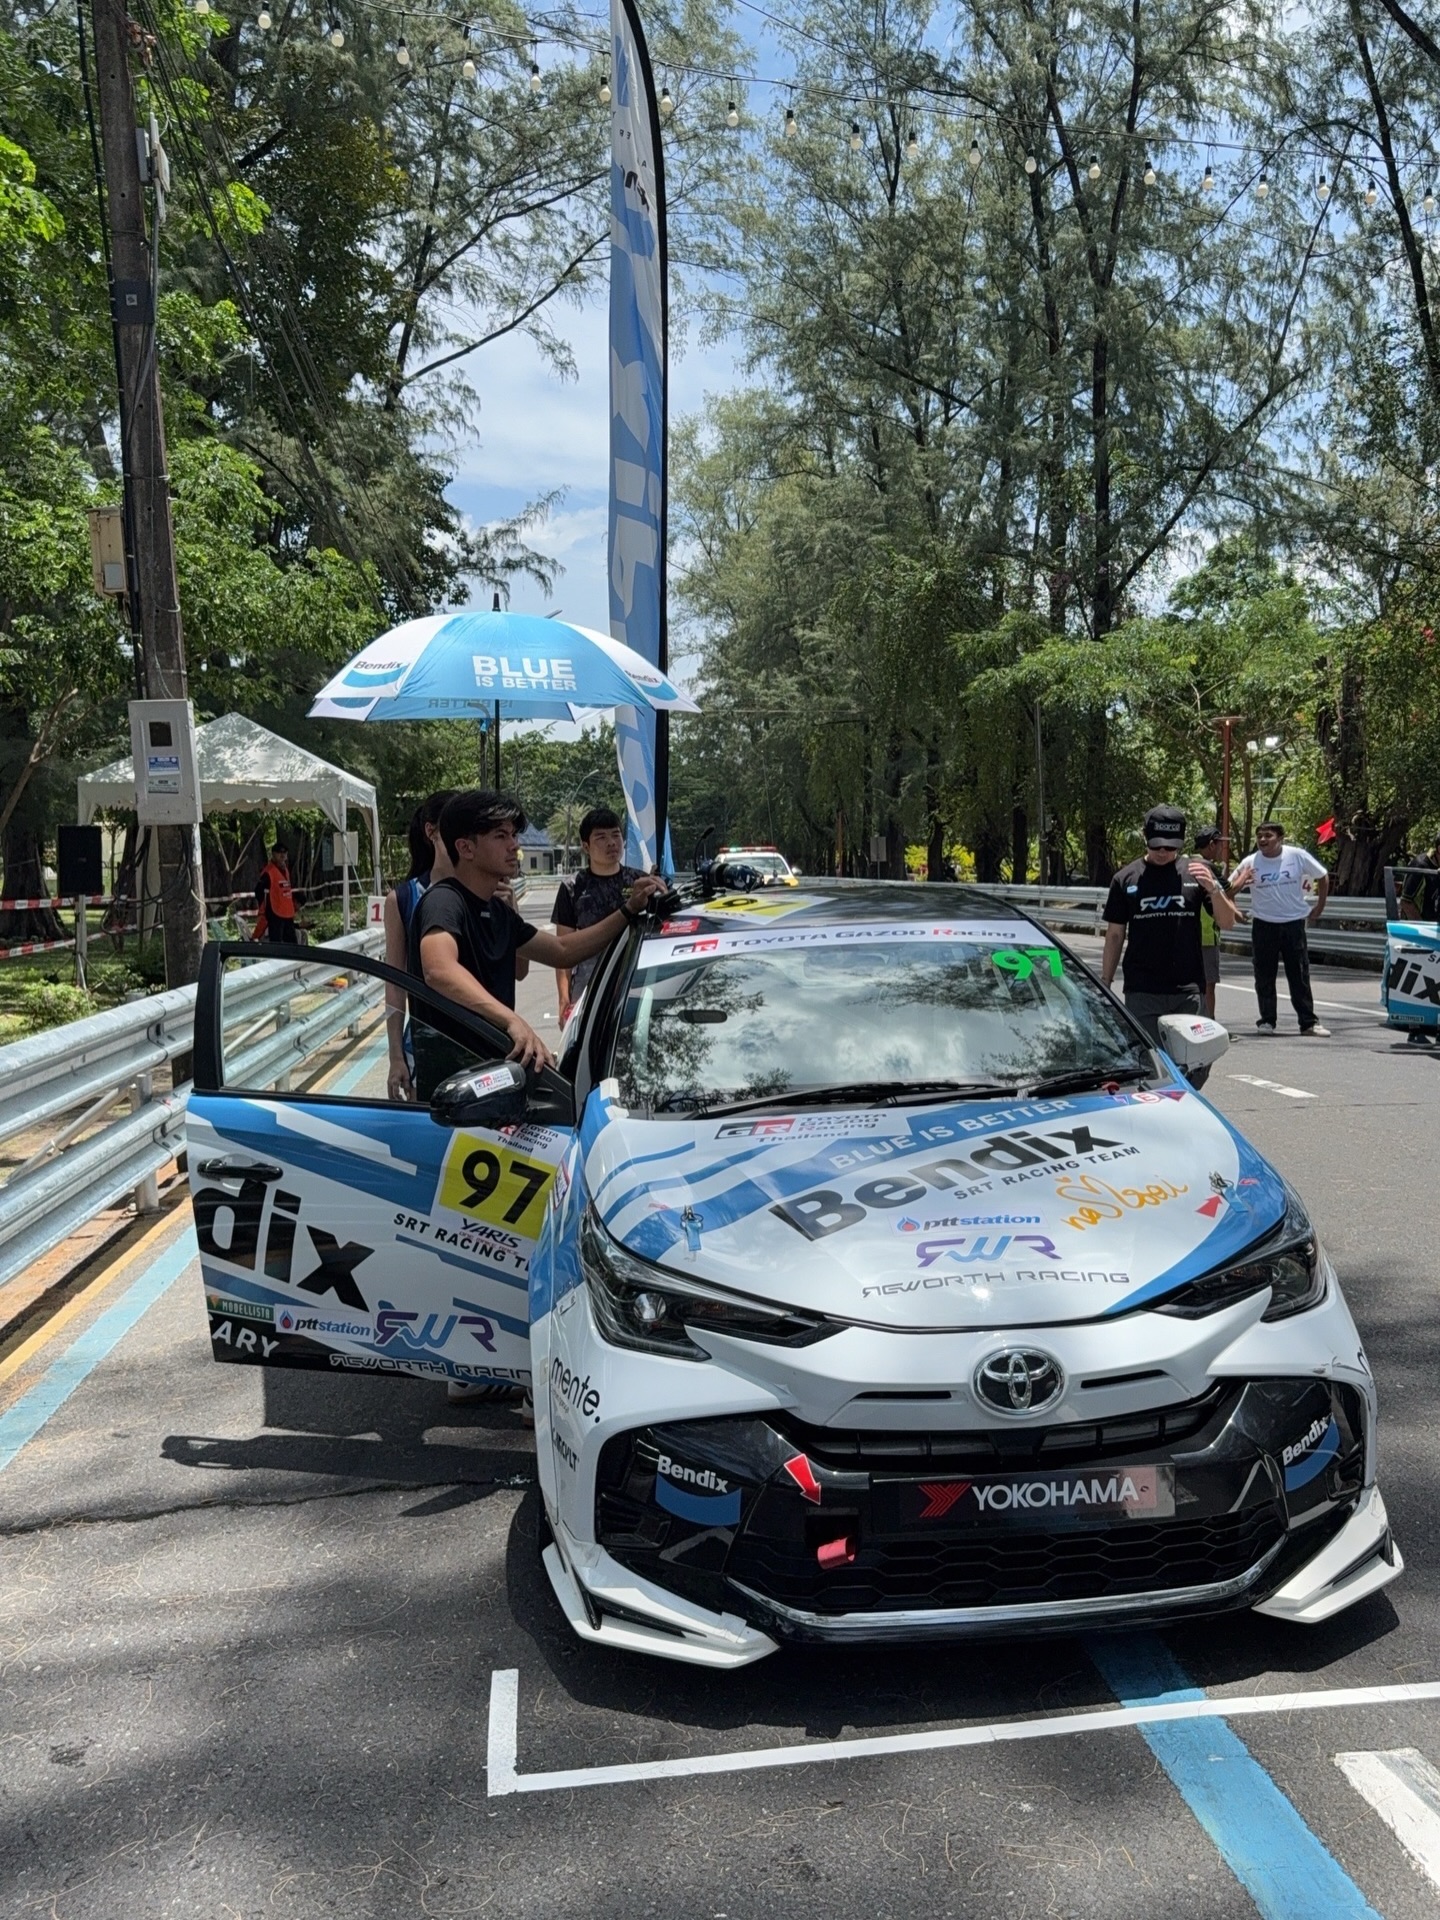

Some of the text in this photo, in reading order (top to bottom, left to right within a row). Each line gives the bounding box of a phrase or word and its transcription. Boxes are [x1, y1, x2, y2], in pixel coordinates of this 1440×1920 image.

[354, 660, 403, 670] Bendix
[472, 655, 575, 680] BLUE
[475, 676, 577, 691] IS BETTER
[1302, 880, 1312, 892] 4
[371, 903, 382, 922] 1
[672, 928, 1016, 956] GR TOYOTA GAZOO Racing
[992, 949, 1064, 980] 97
[798, 1122, 877, 1132] Racing
[802, 1113, 887, 1122] TOYOTA
[520, 1128, 552, 1143] GAZOO
[522, 1122, 559, 1139] TOYOTA
[714, 1118, 880, 1139] GR GAZOO
[756, 1131, 849, 1143] Thailand
[829, 1100, 1077, 1169] BLUE IS BETTER
[497, 1135, 534, 1153] Thailand
[516, 1132, 548, 1150] Racing
[954, 1145, 1141, 1200] SRT RACING TEAM
[459, 1149, 551, 1224] 97
[768, 1125, 1124, 1241] Bendix
[393, 1213, 530, 1272] SRT RACING T
[1018, 1271, 1130, 1284] RACING
[222, 1301, 272, 1320] MODELLISTA
[209, 1314, 280, 1358] ARY
[1282, 1416, 1330, 1467] Bendix
[657, 1454, 728, 1494] Bendix
[972, 1476, 1140, 1511] YOKOHAMA
